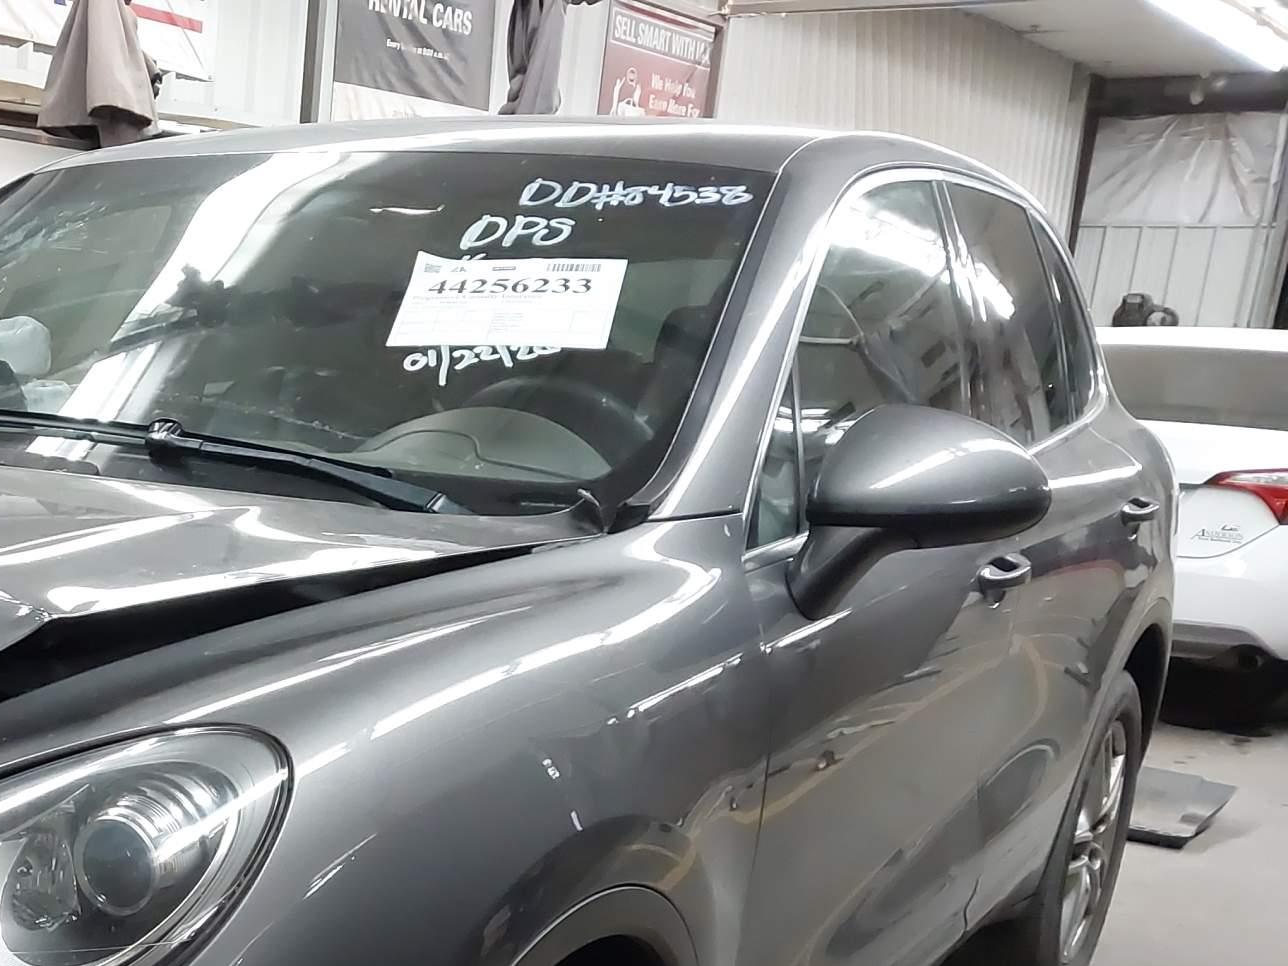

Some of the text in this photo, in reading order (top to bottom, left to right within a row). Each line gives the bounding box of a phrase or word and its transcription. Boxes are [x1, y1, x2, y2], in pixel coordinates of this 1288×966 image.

[432, 3, 473, 36] CARS
[614, 14, 637, 43] SELL
[637, 22, 672, 53] SMART
[671, 31, 696, 60] WITH
[427, 278, 593, 294] 44256233
